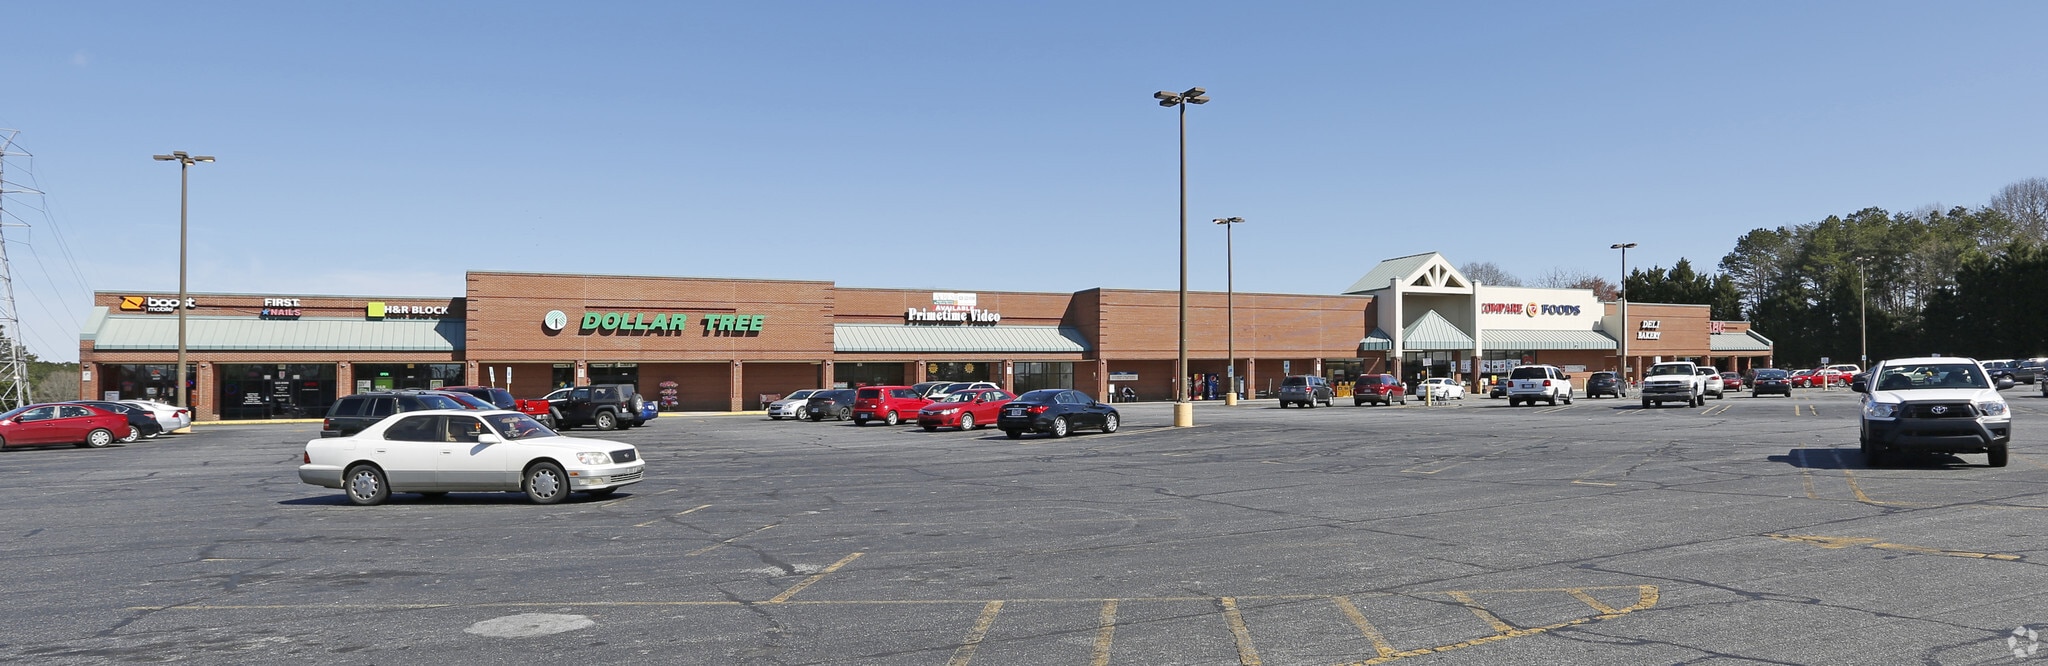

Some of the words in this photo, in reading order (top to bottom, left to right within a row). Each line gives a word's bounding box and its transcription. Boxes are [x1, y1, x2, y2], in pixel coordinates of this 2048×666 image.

[264, 298, 301, 307] FIRST
[270, 308, 302, 316] NAILS
[384, 305, 409, 314] H&R
[411, 305, 449, 315] BLOCK
[908, 307, 967, 321] Primetime
[970, 308, 1001, 322] Video
[1541, 304, 1581, 316] FOODS
[581, 312, 688, 331] DOLLAR
[704, 314, 765, 331] TREE
[1642, 320, 1660, 329] DELI
